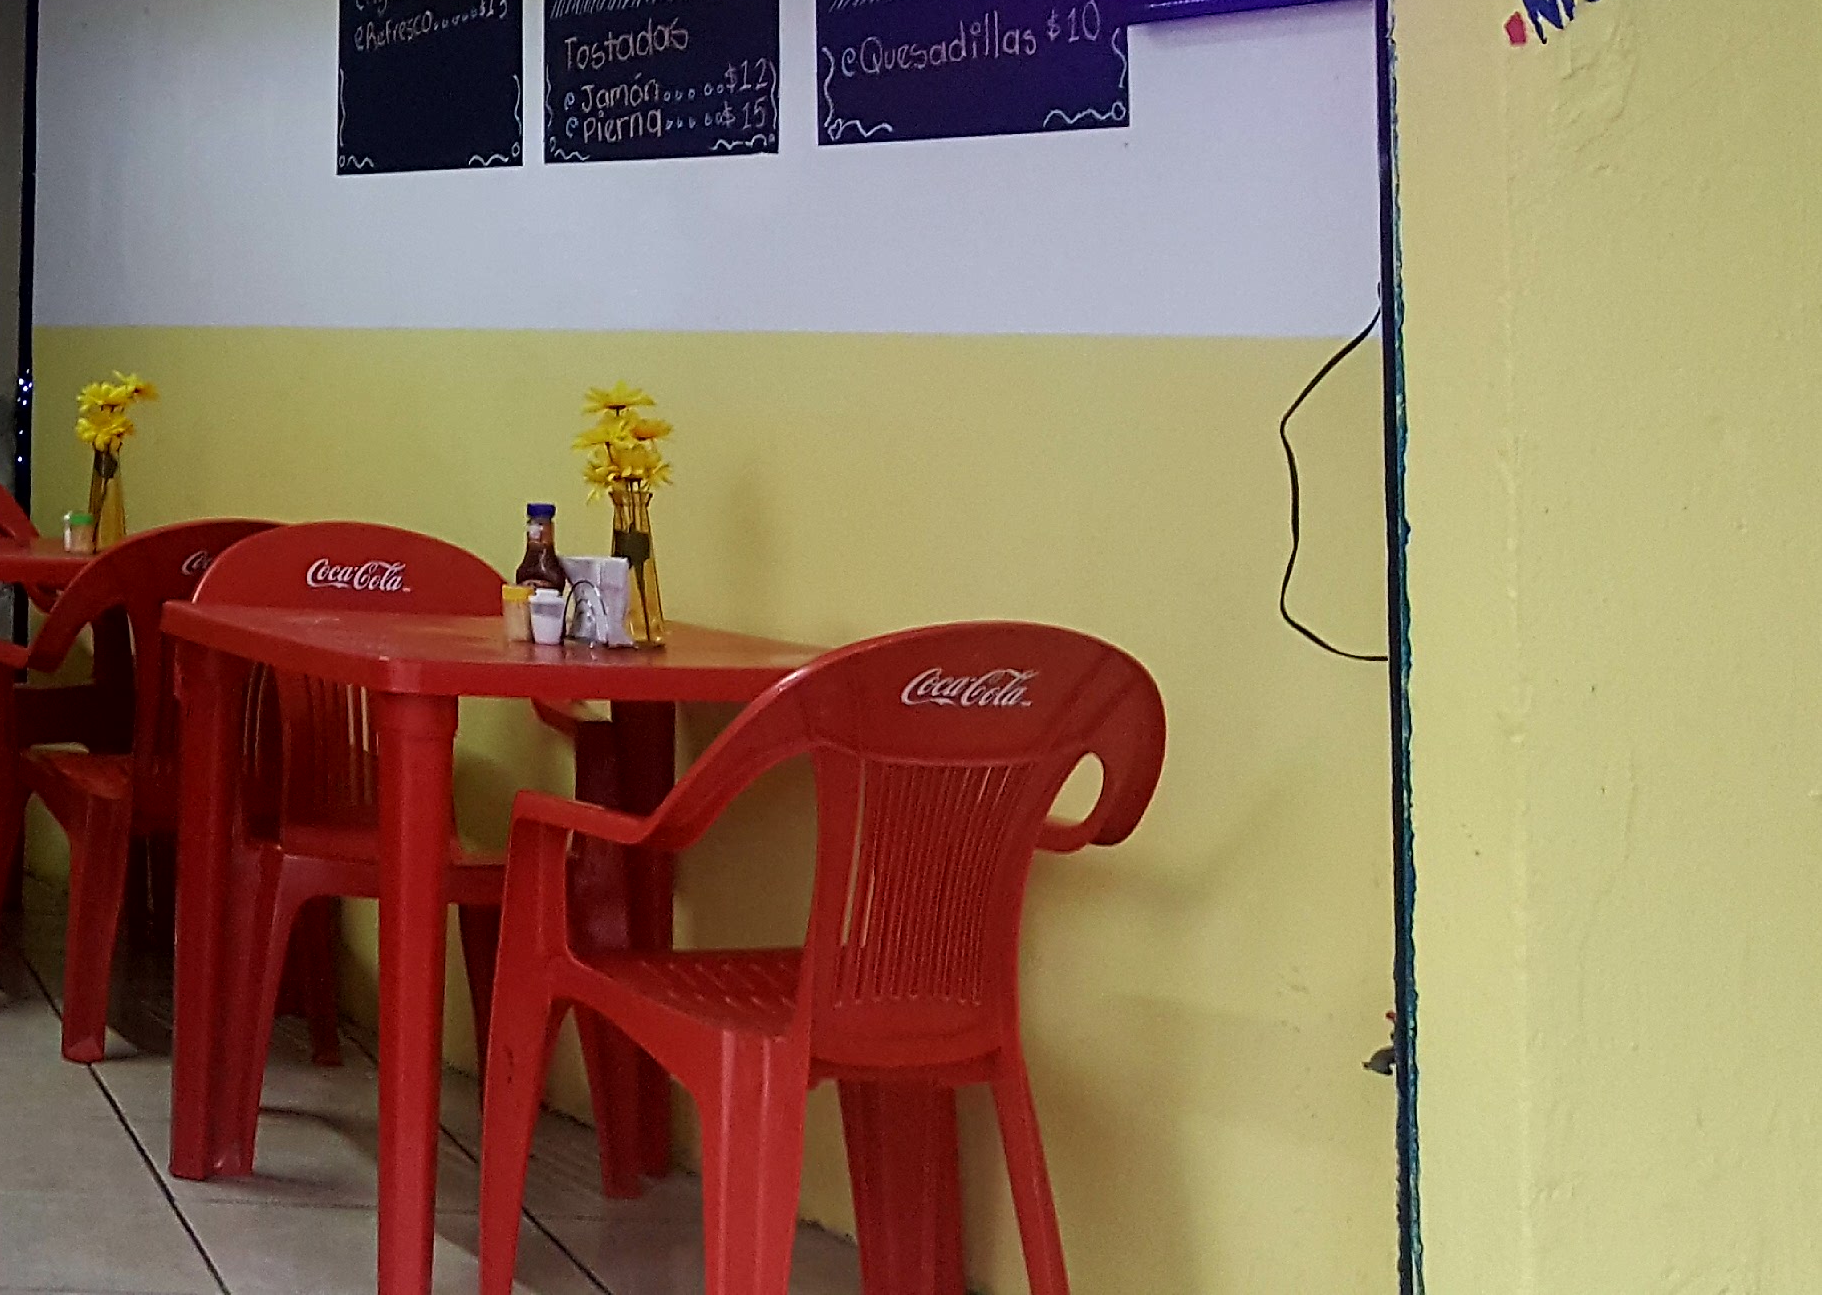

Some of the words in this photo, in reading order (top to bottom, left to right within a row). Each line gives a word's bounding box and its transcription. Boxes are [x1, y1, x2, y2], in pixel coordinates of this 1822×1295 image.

[563, 17, 689, 71] Tostadas
[859, 9, 1037, 76] Quesadillas
[580, 72, 659, 114] Jamón
[723, 57, 769, 94] $12
[722, 95, 767, 131] $15
